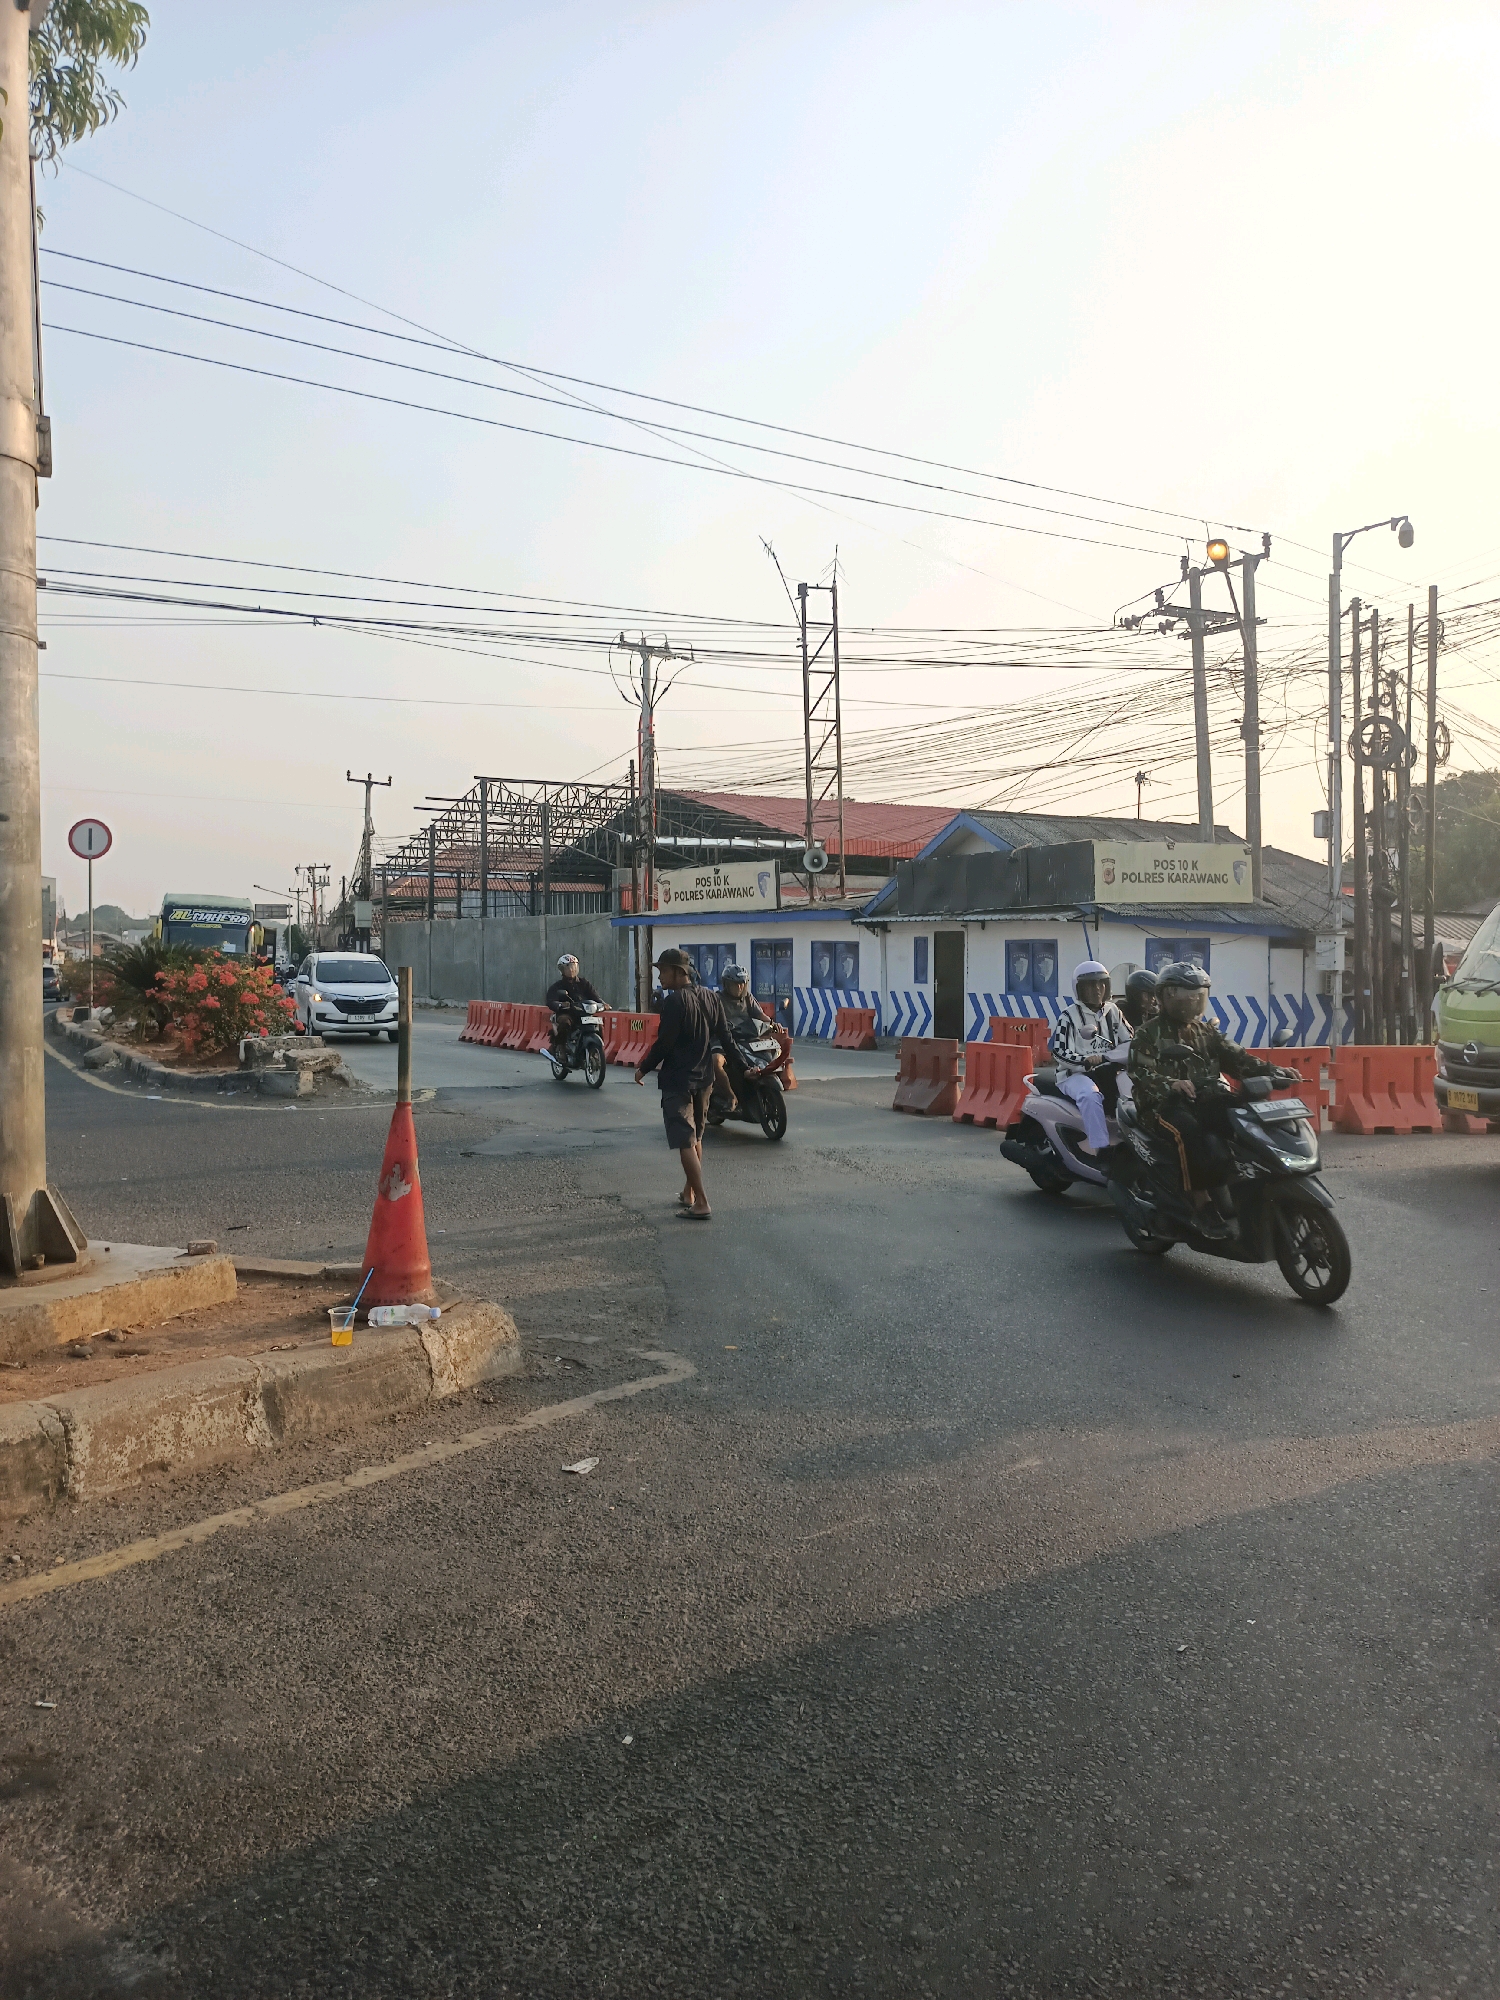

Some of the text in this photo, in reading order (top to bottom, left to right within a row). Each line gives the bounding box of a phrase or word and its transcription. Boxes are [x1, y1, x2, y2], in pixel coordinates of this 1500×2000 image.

[1153, 859, 1199, 871] POS 10 K
[695, 874, 730, 888] POS 10 K
[1121, 872, 1229, 884] POLRES KARAWANG
[674, 888, 704, 902] POLRES
[705, 886, 755, 900] KARAWANG
